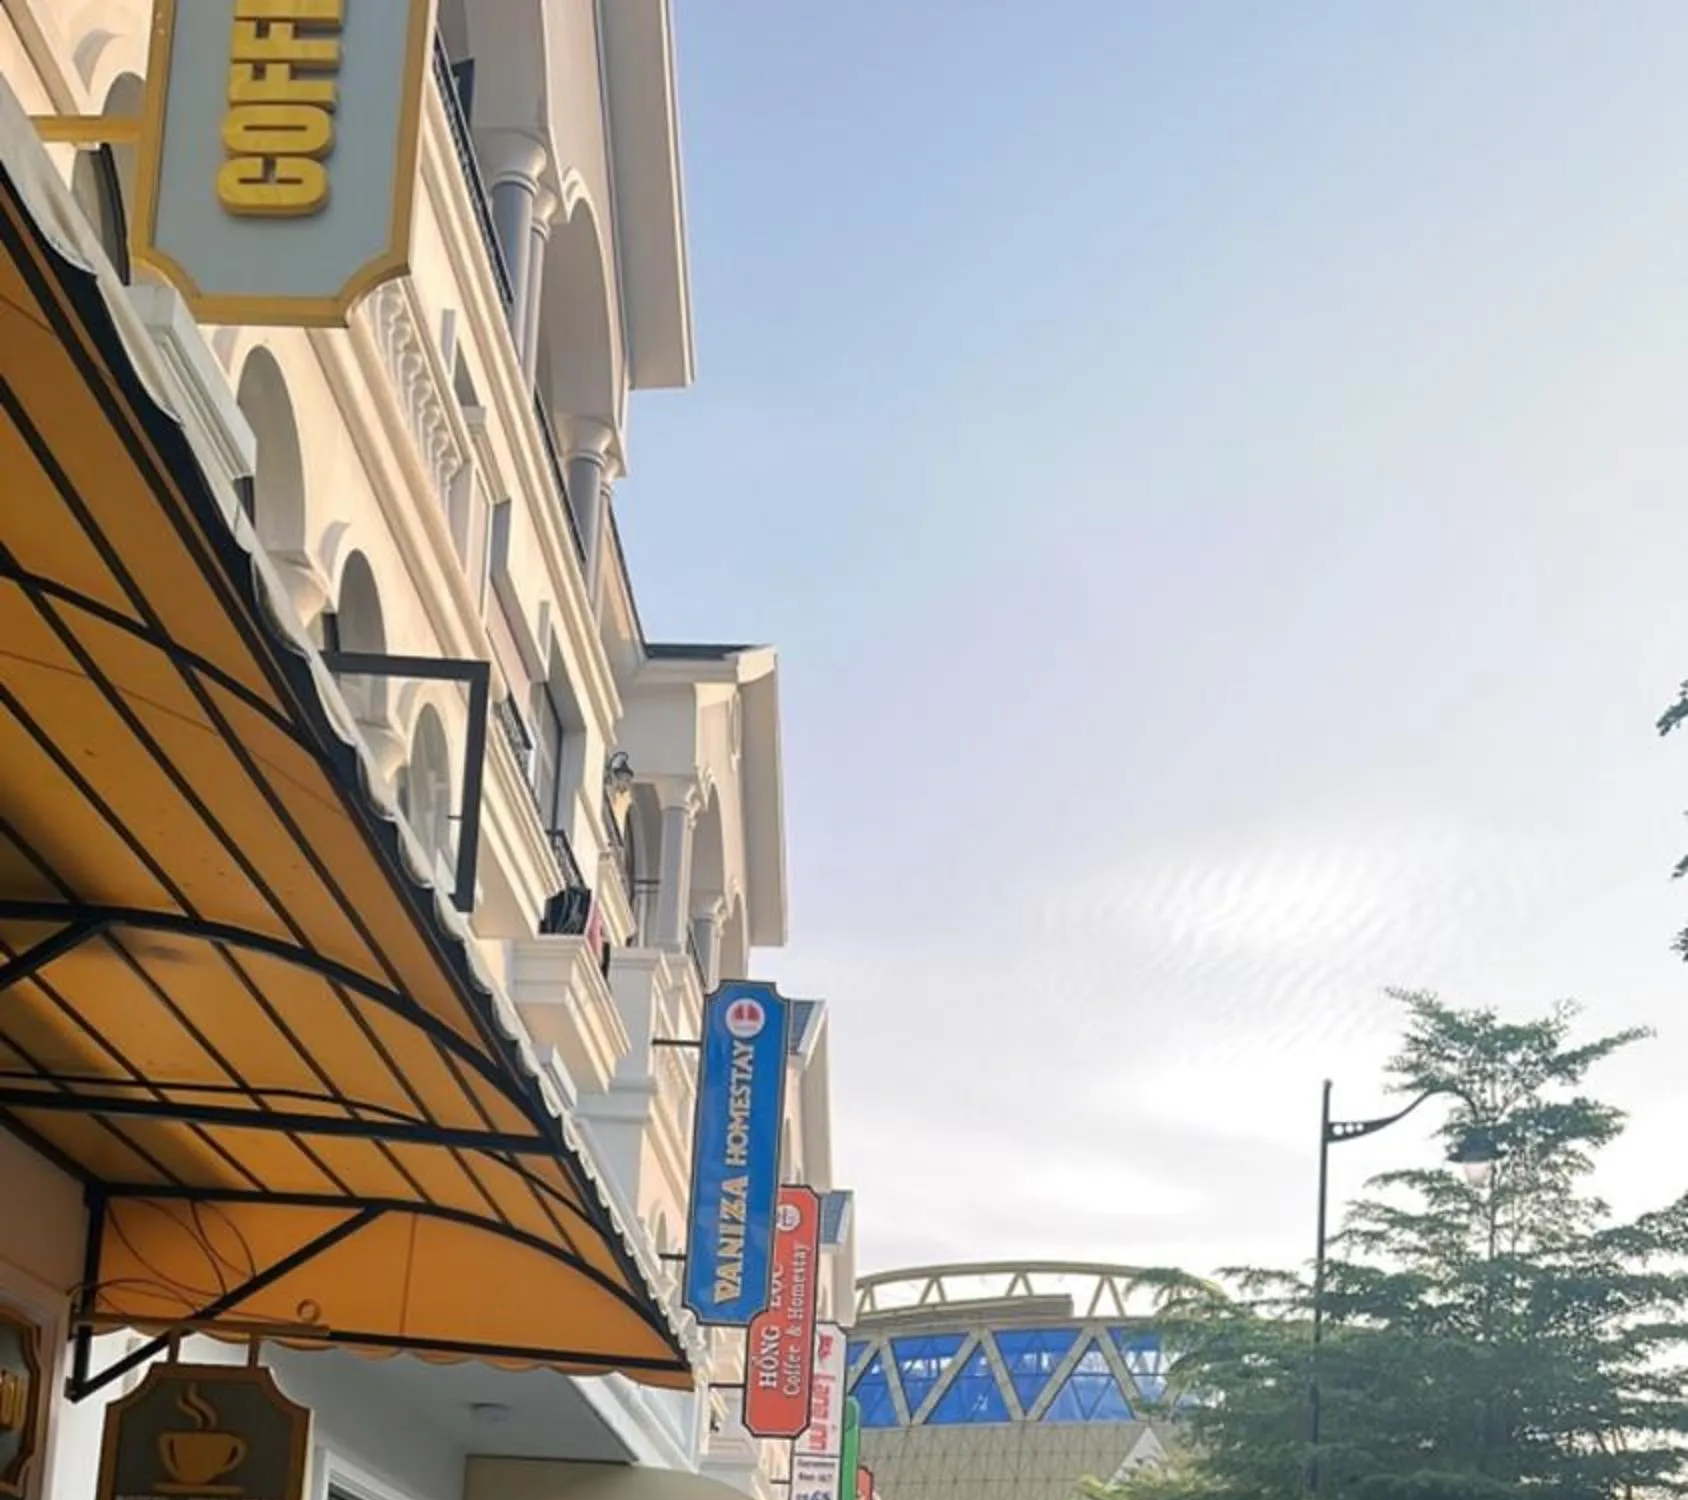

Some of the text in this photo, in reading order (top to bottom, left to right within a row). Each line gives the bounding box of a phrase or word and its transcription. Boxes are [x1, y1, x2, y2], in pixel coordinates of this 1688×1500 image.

[713, 1040, 756, 1304] VANIZA HOMESTAY
[787, 1240, 811, 1320] Homestay
[782, 1344, 802, 1396] Coffee
